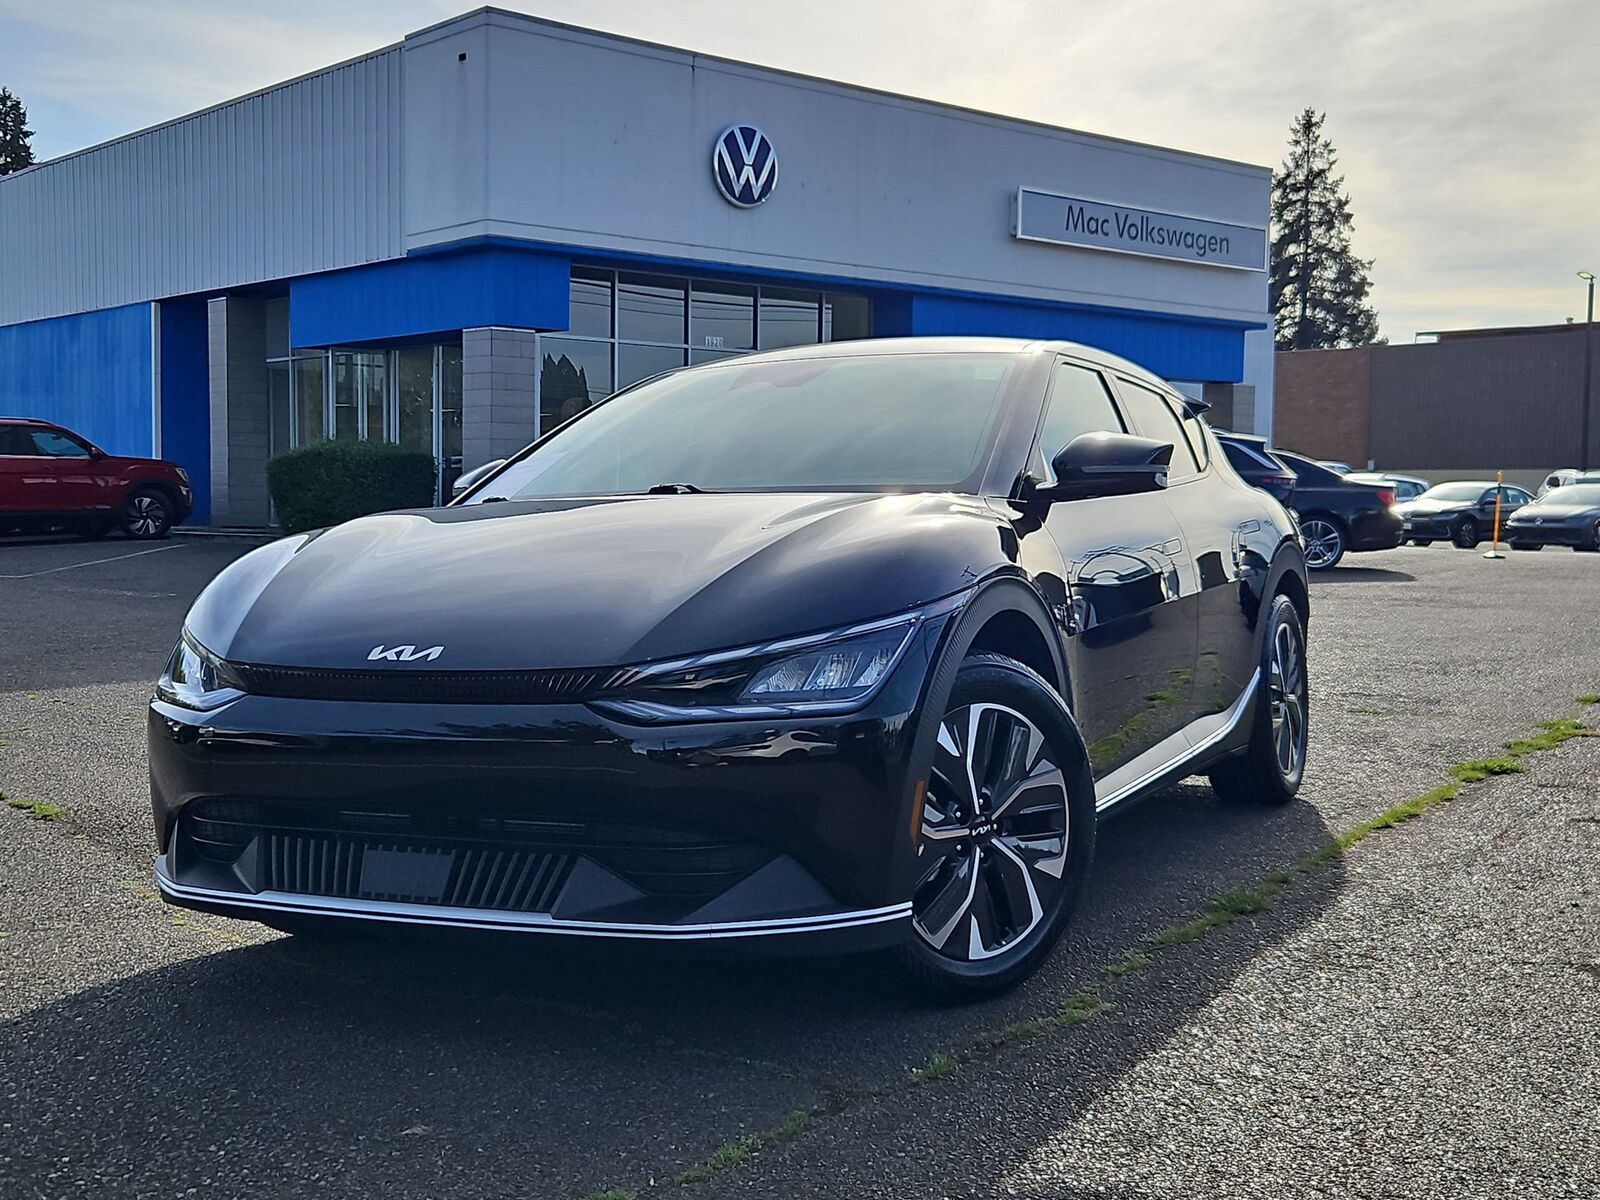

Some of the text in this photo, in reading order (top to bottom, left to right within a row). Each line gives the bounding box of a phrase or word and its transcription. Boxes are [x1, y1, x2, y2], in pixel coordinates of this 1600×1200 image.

[717, 126, 777, 202] VW
[1065, 204, 1230, 257] Mac Volkswagen
